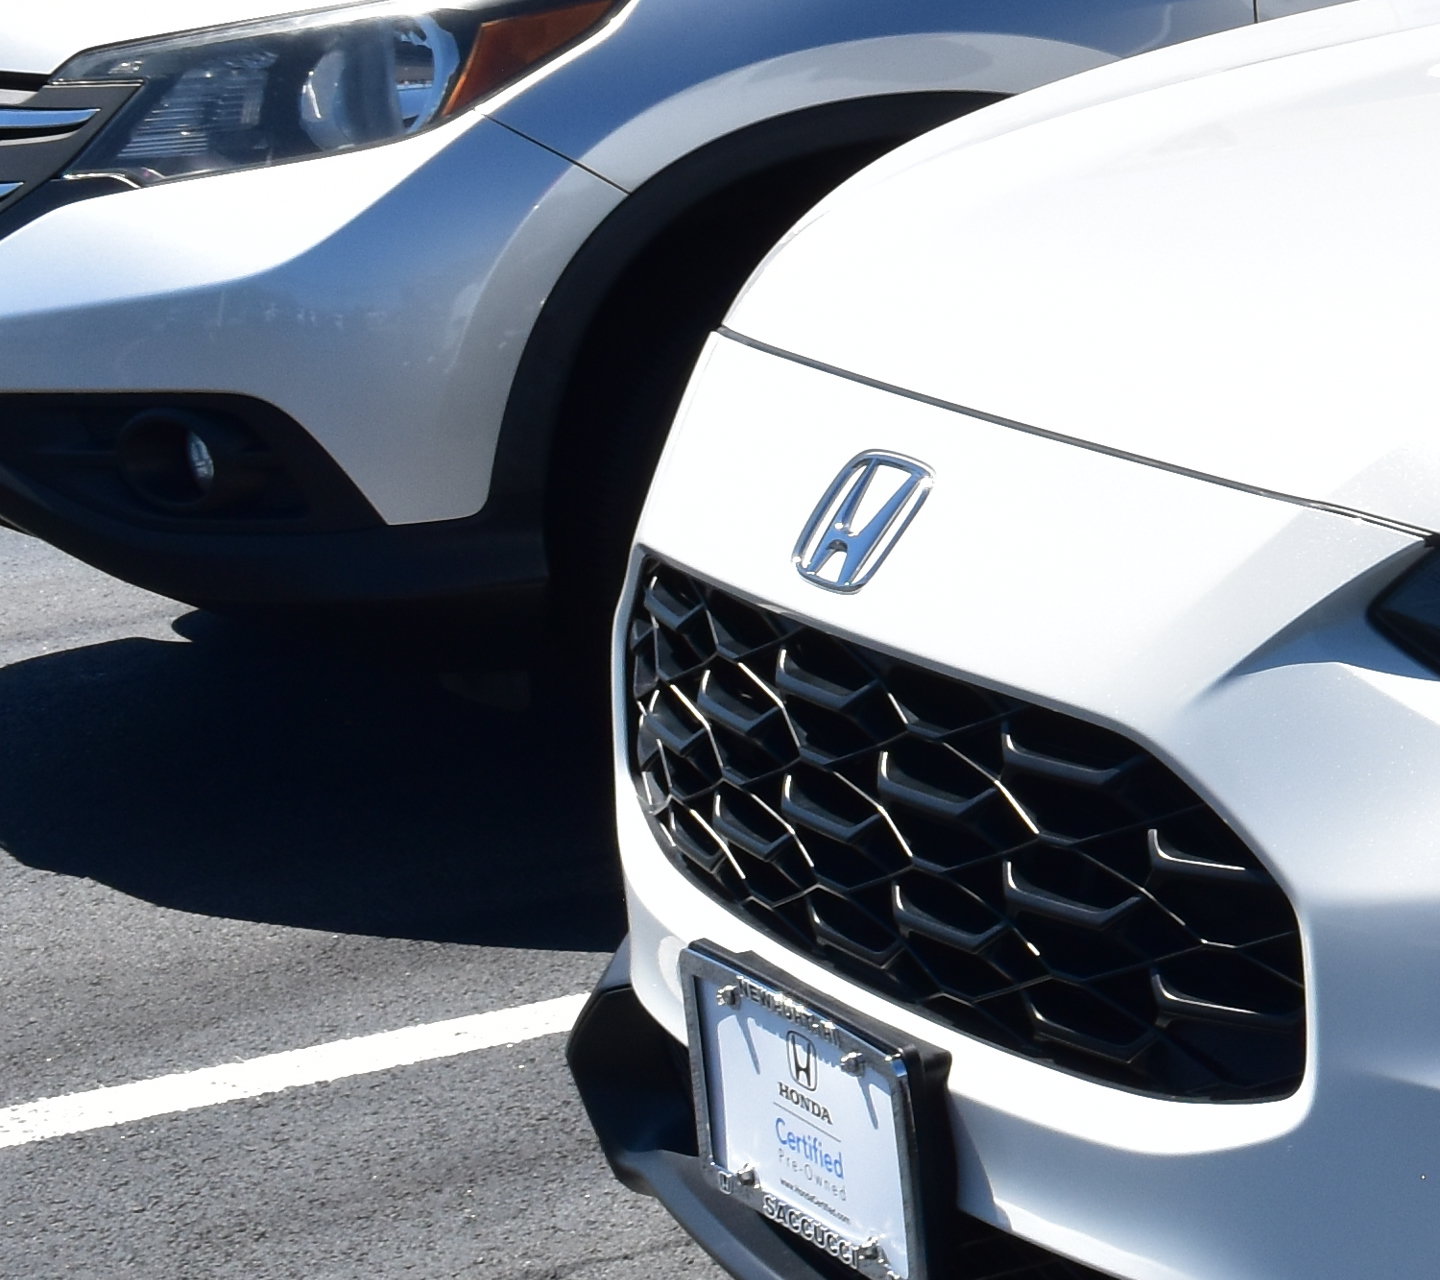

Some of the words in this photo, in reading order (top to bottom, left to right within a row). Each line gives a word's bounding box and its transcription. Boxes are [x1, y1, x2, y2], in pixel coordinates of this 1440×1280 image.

[778, 1081, 833, 1125] HONDA
[775, 1117, 844, 1180] Certified
[777, 1147, 847, 1202] Pre-Owned
[762, 1195, 859, 1269] SACCUCCI
